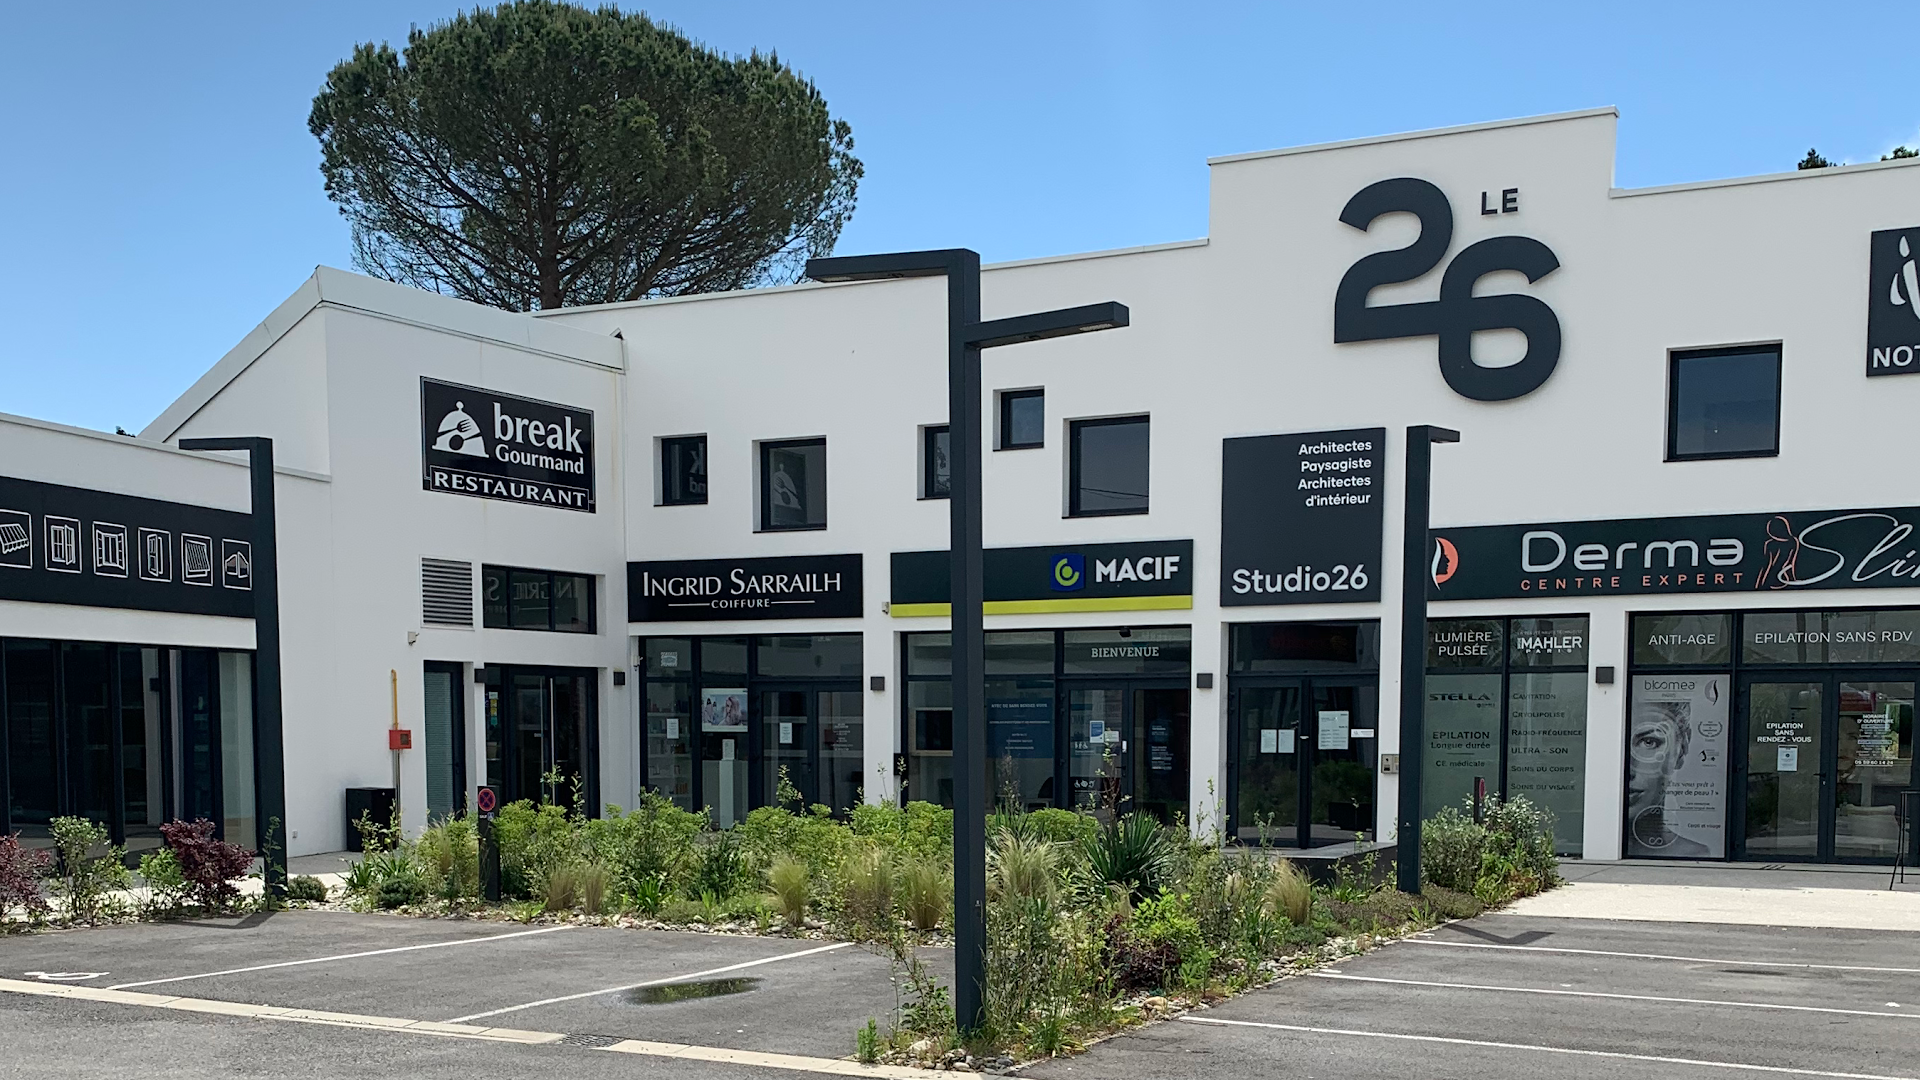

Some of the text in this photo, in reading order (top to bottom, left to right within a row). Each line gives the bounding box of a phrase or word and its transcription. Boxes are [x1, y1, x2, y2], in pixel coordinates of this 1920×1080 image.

[1481, 188, 1519, 216] LE
[1334, 177, 1562, 402] 26
[493, 401, 583, 454] break
[1298, 440, 1372, 455] Architectes
[495, 444, 584, 475] Gourmand
[1301, 457, 1372, 474] Paysagiste
[433, 471, 586, 507] RESTAURANT
[1298, 476, 1371, 490] Architectes
[1305, 493, 1371, 507] d'intérieur
[1521, 530, 1744, 573] Derma
[1095, 555, 1180, 583] MACIF
[1231, 564, 1369, 594] Studio26
[1521, 571, 1744, 591] CENTRE EXPERT
[711, 598, 770, 609] COIFFURE
[1435, 629, 1493, 643] LUMIÈRE
[1521, 636, 1582, 649] MAHLER
[1648, 633, 1716, 646] ANTI-AGE
[1755, 630, 1913, 644] EPILATION SANS RDV
[1091, 646, 1159, 658] BIENVENUE
[1438, 643, 1488, 656] PULSÉE
[1644, 680, 1695, 690] bloomea
[1429, 691, 1491, 701] STELLA
[1432, 731, 1490, 739] EPILATION
[1431, 741, 1491, 750] Longue durée
